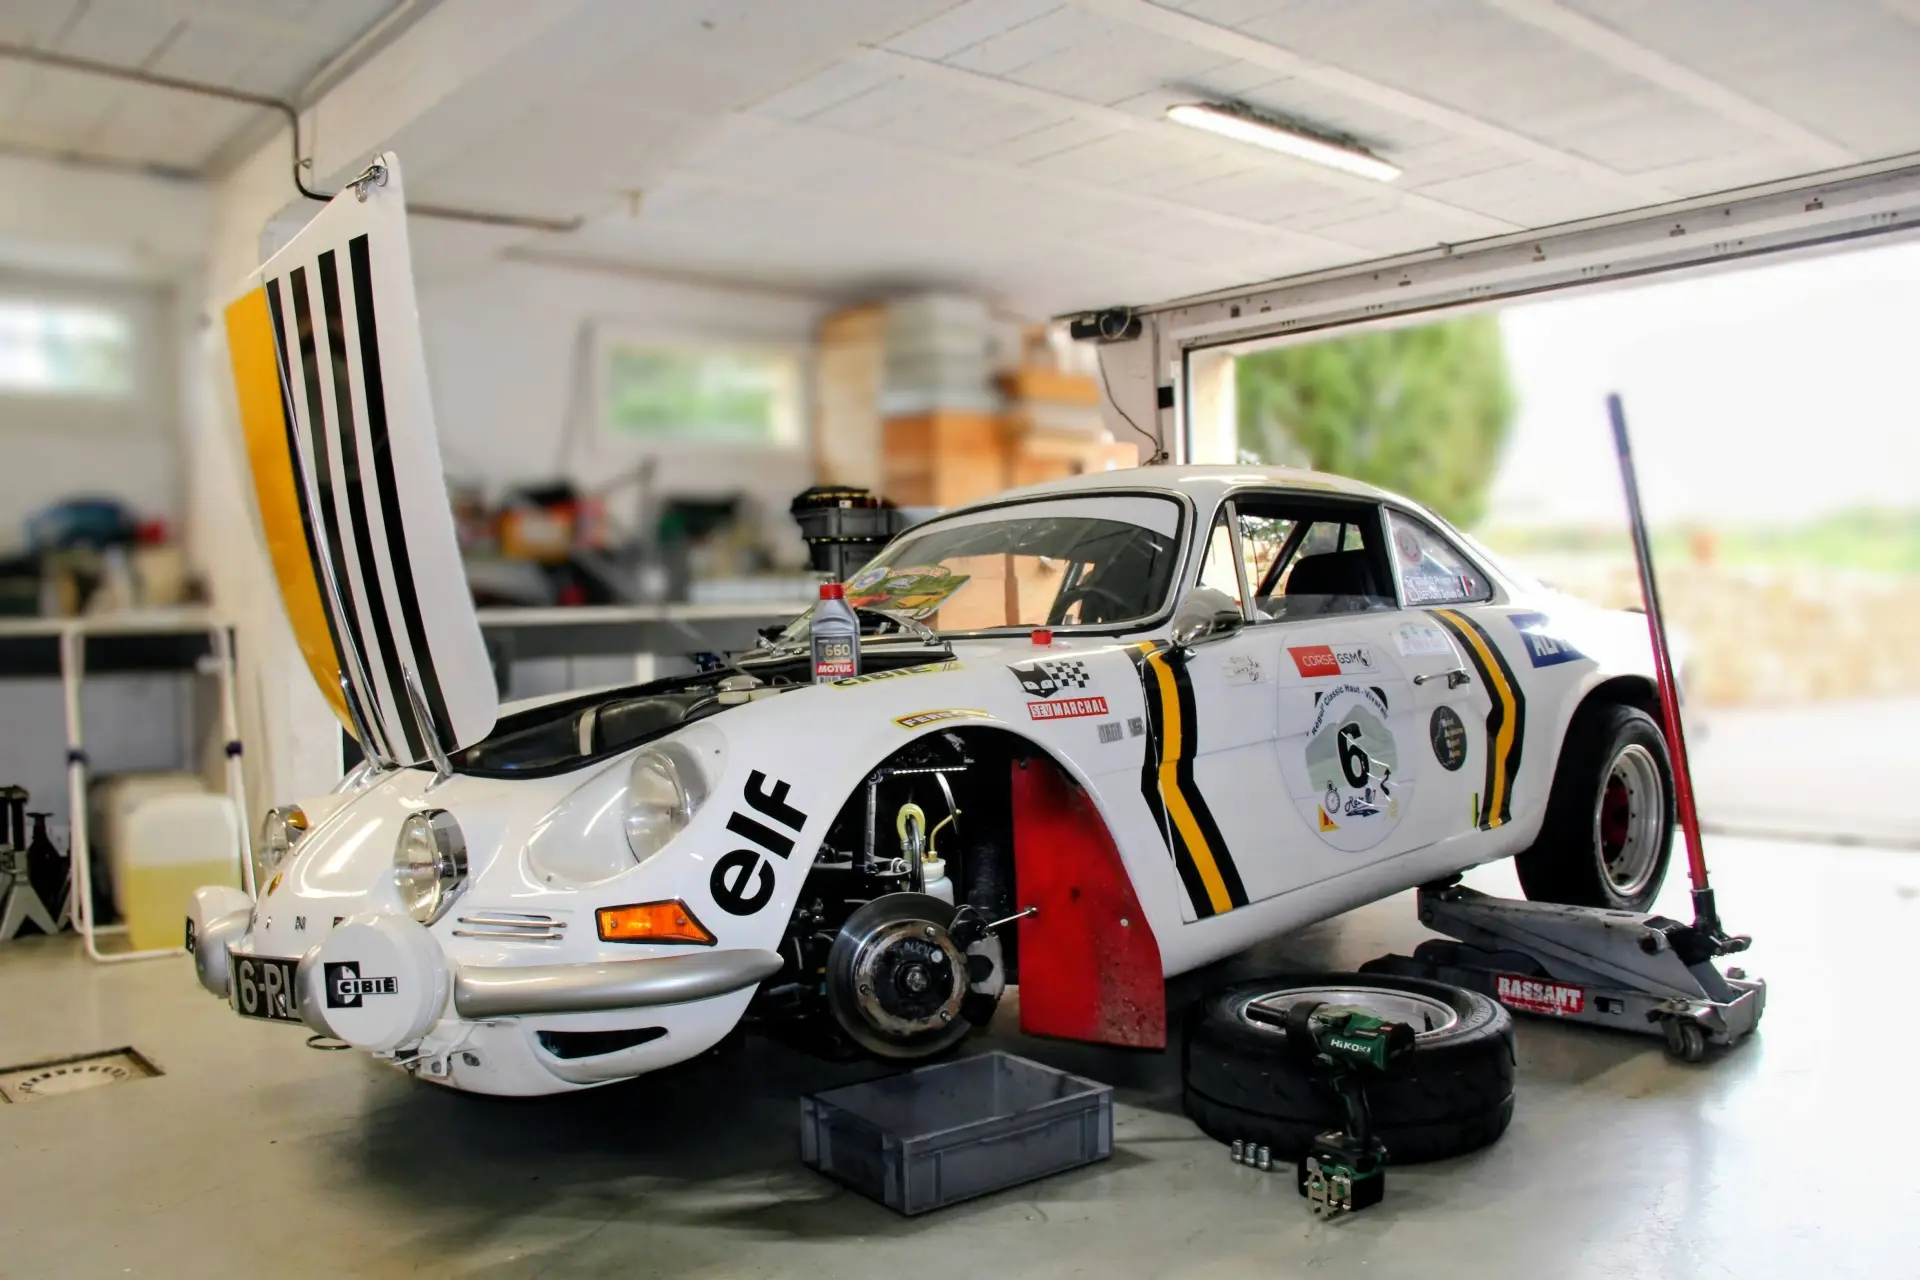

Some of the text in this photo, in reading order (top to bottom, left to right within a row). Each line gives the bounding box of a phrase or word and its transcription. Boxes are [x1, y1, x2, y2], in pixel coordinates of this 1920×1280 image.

[825, 644, 850, 657] 660
[1302, 652, 1360, 667] CORSE GSM
[818, 664, 853, 673] MOTUL
[1052, 699, 1107, 716] MARCHAL
[1337, 722, 1370, 789] 6
[709, 769, 808, 916] elf
